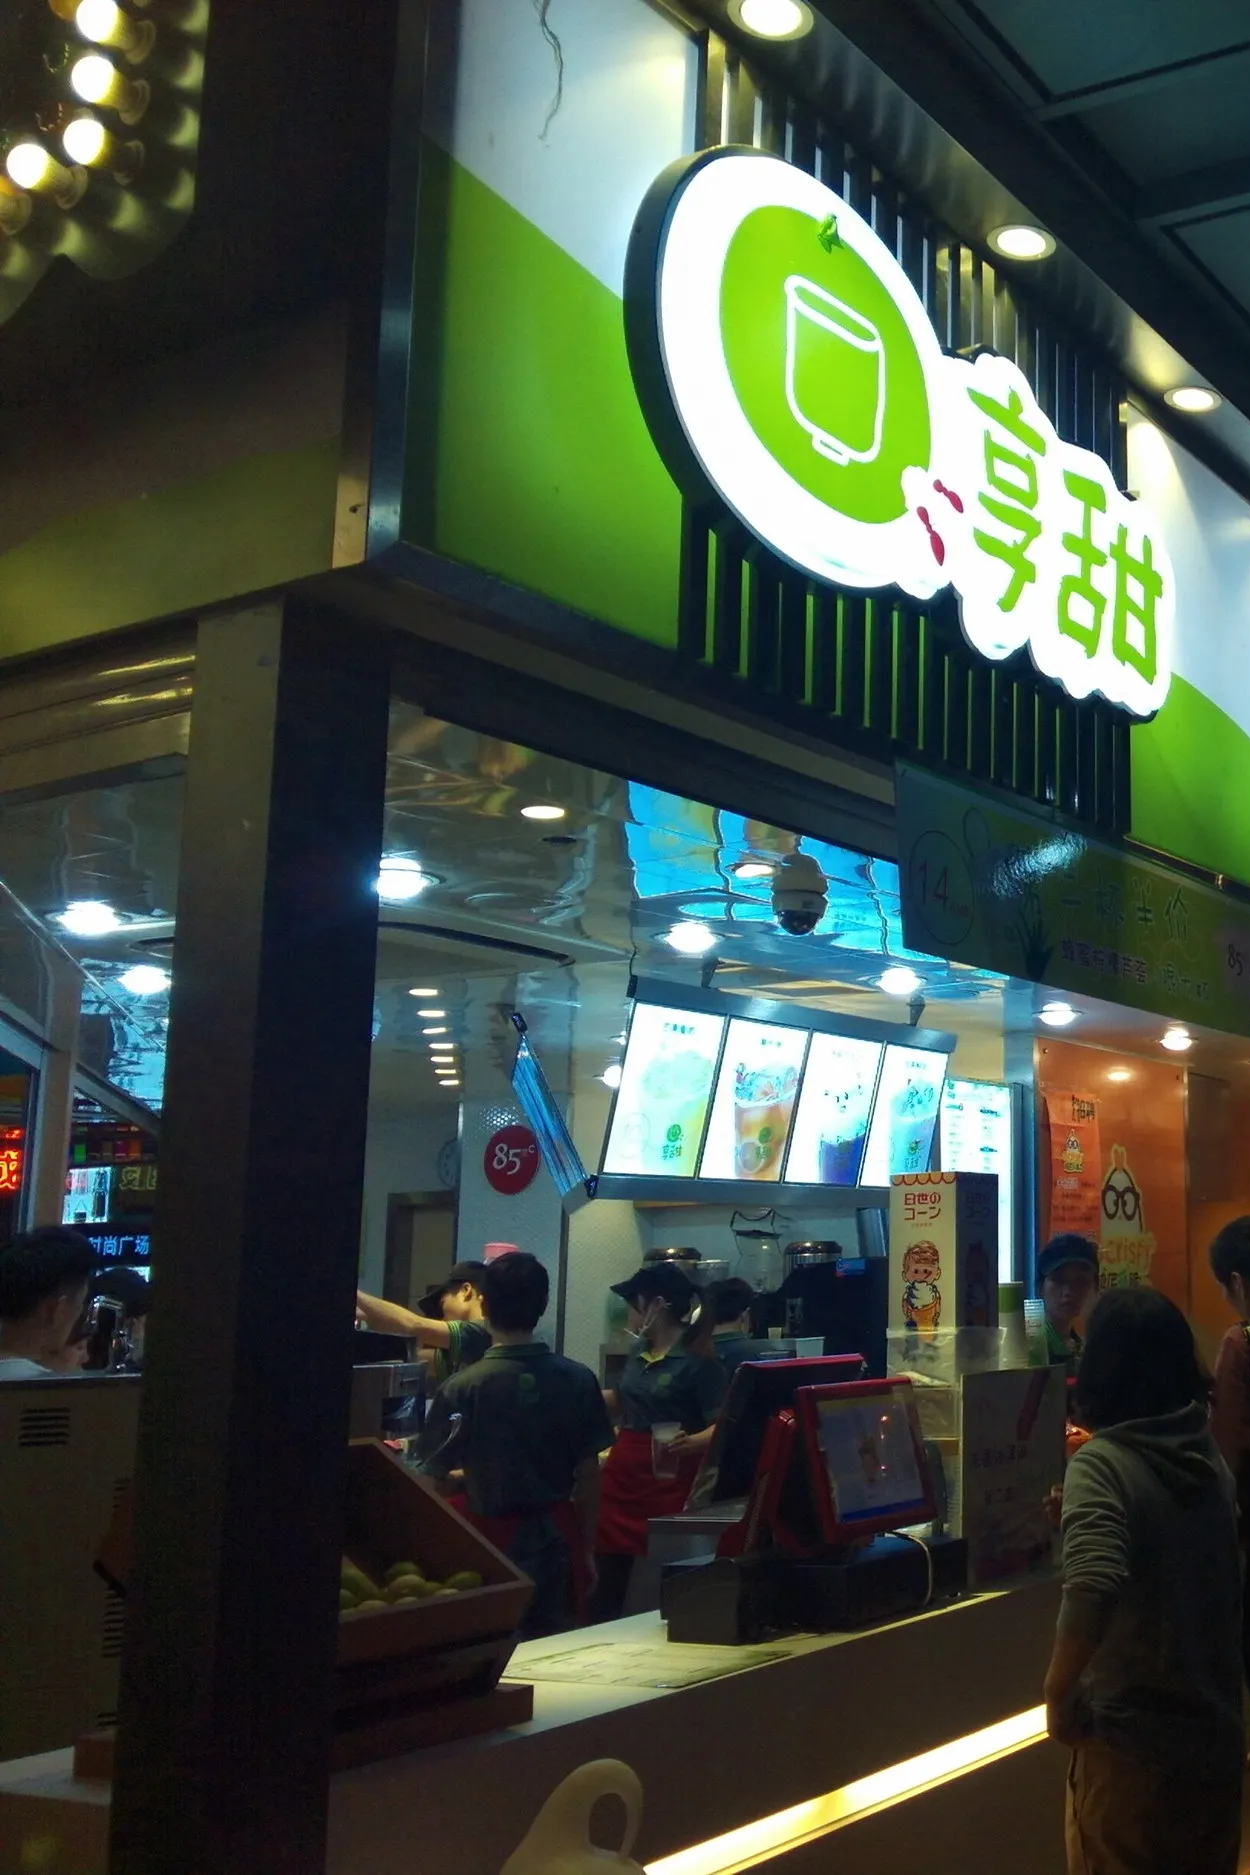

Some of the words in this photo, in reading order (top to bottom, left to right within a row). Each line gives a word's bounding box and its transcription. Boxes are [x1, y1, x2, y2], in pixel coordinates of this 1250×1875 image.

[967, 385, 1163, 685] 享甜
[904, 1191, 941, 1206] 日世の
[904, 1206, 941, 1221] コーン
